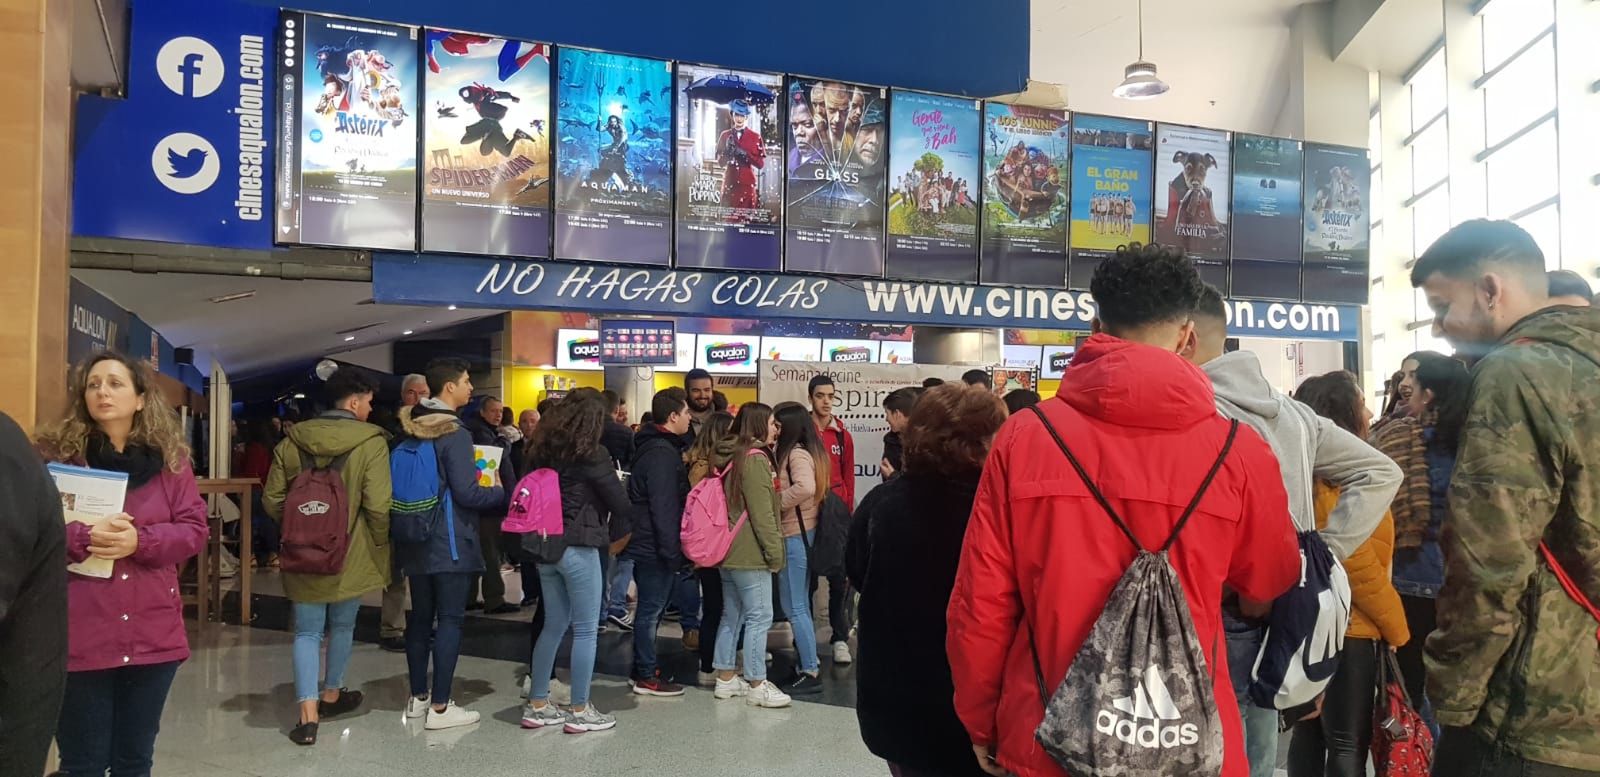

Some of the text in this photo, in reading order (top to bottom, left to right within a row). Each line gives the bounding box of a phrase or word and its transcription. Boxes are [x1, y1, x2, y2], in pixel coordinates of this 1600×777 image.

[235, 35, 267, 222] cinesaqualon.com
[335, 112, 389, 138] Astérix
[1020, 116, 1059, 131] LUNNIS
[431, 155, 535, 187] SPIDER-MAN
[814, 168, 859, 184] GLASS
[1087, 168, 1138, 181] EL GRAN
[581, 181, 648, 194] AQUAMAN
[695, 179, 717, 192] MARY
[1095, 179, 1130, 193] BAÑO
[689, 187, 721, 204] POPPINS
[1176, 227, 1208, 238] FAMILIA
[475, 262, 828, 309] NO HAGAS COLAS
[863, 281, 1340, 333] www.cinesn.com
[72, 304, 106, 342] AQUALON
[573, 345, 600, 358] aqua
[711, 348, 746, 361] aqualon
[835, 351, 867, 363] aqualon
[1053, 358, 1074, 371] aqua
[1096, 709, 1199, 749] addas
